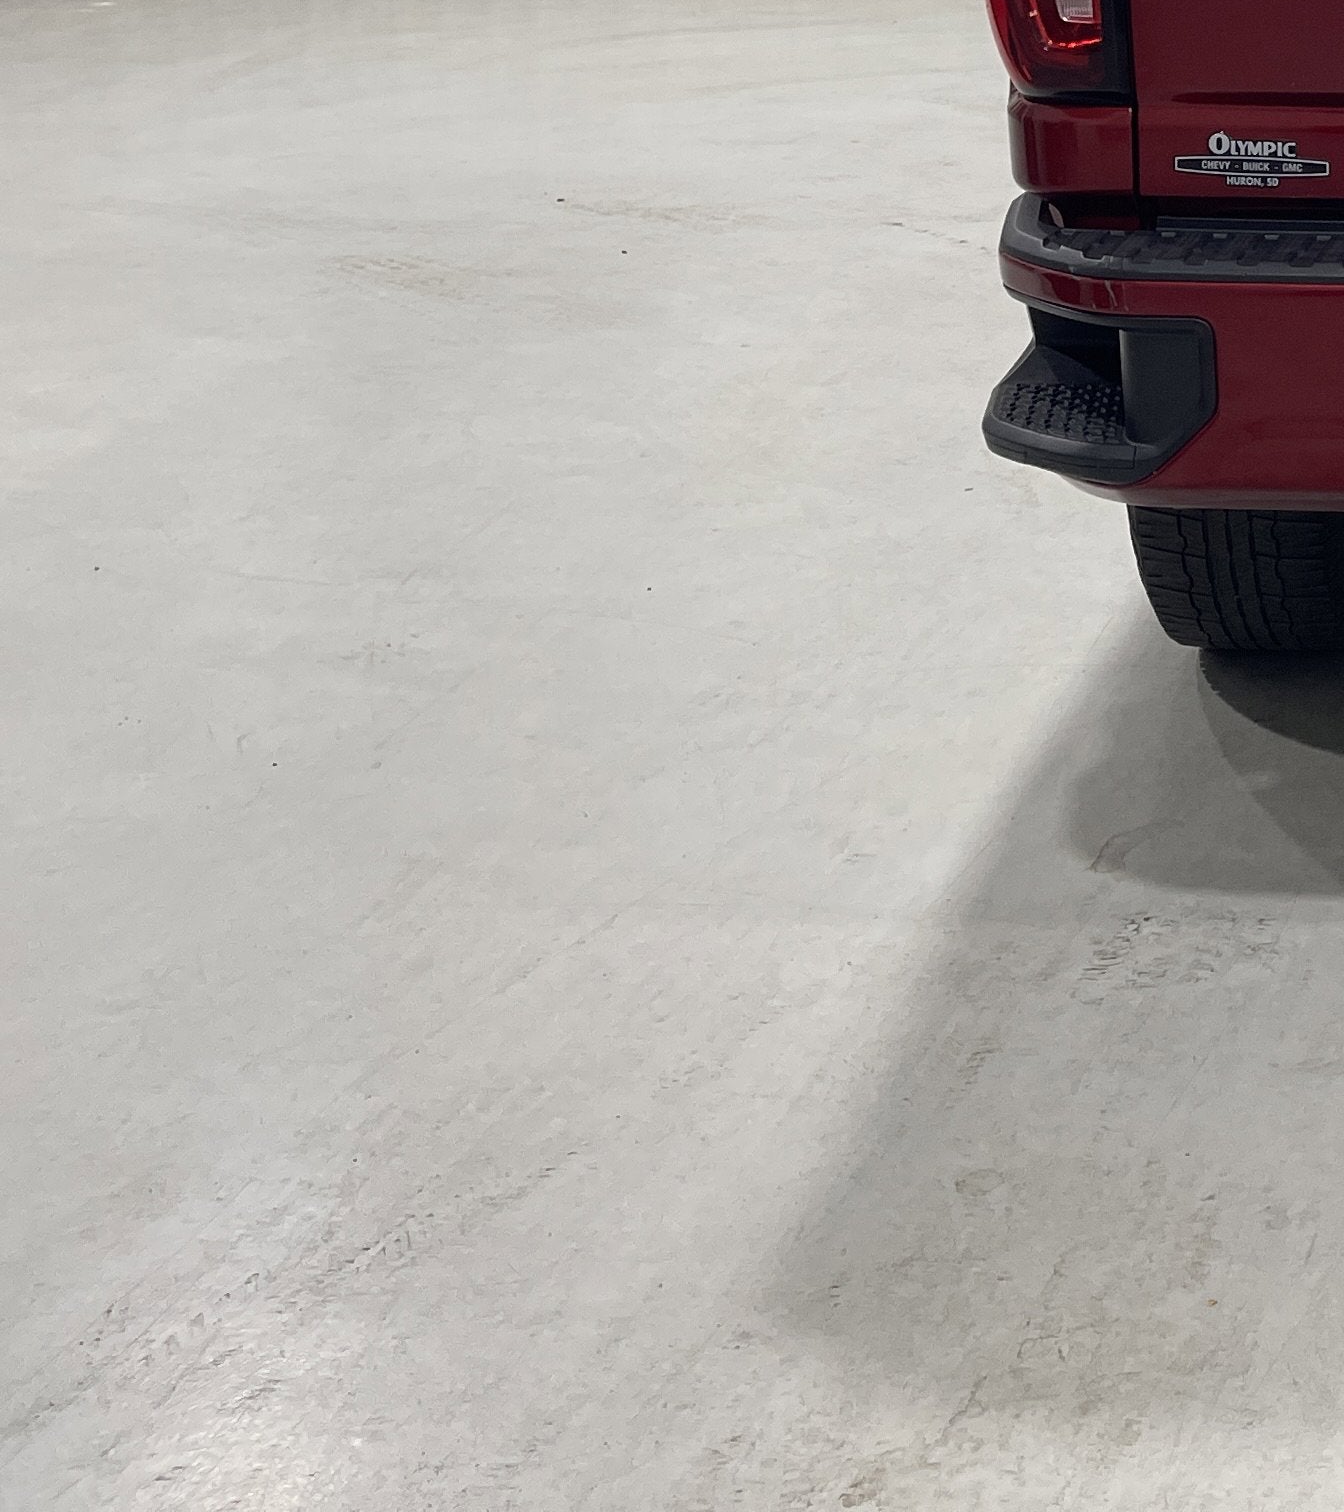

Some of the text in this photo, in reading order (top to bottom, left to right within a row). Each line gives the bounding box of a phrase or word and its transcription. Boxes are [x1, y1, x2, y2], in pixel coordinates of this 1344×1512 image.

[1208, 131, 1297, 158] OLYMPIC
[1201, 160, 1303, 172] CHEVY BUICK GMC
[1226, 176, 1279, 188] HURON, SD
